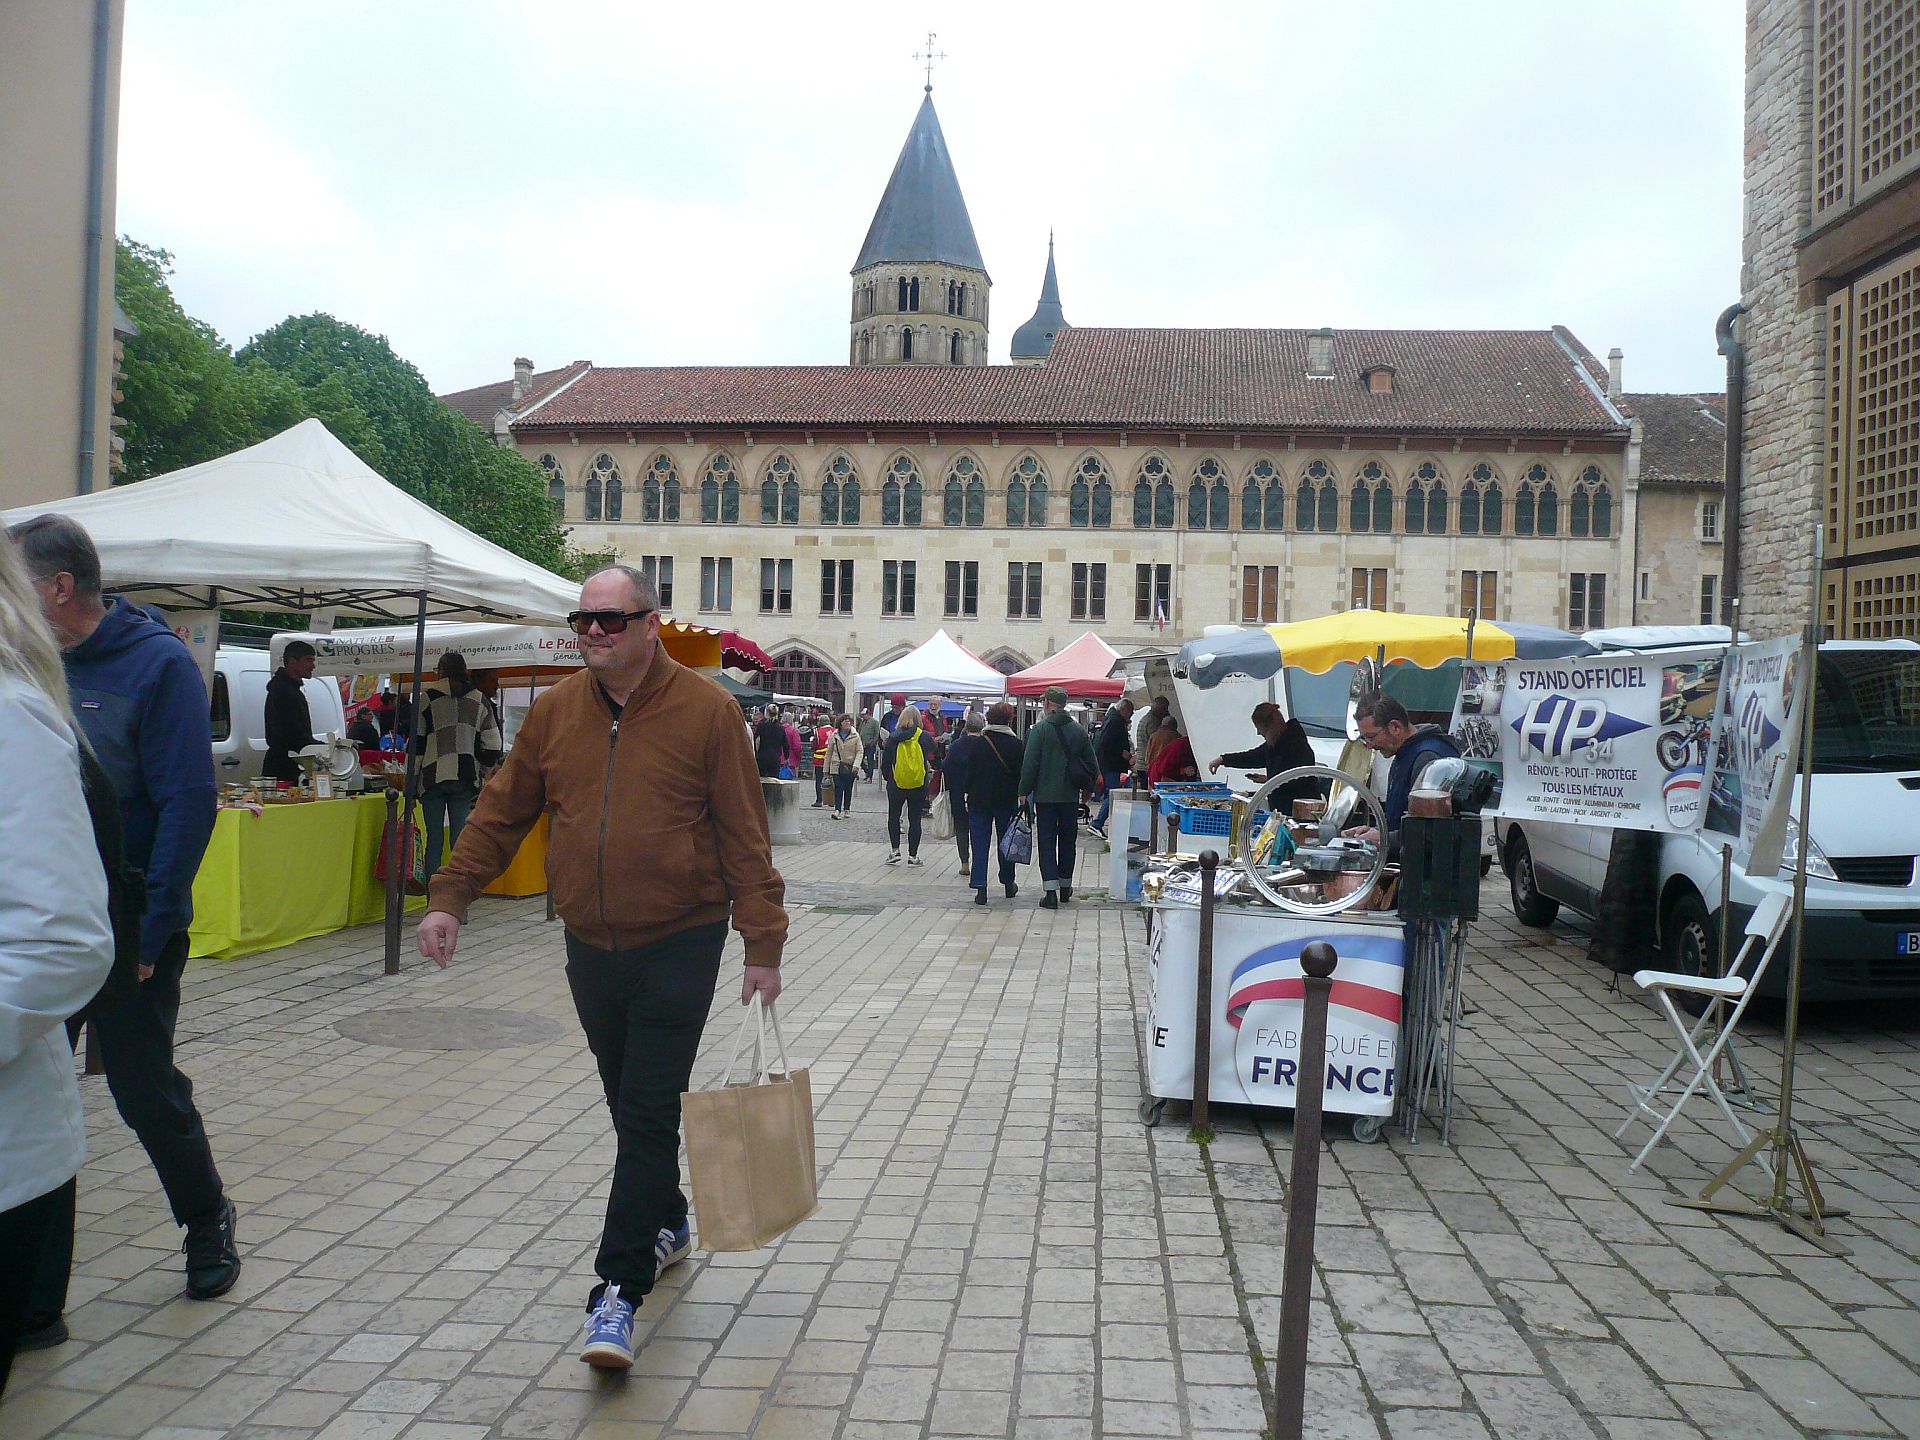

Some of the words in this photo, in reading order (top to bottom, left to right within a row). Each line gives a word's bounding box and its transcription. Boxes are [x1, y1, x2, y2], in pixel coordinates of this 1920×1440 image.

[398, 649, 418, 658] depui
[486, 643, 512, 654] depuis
[538, 638, 554, 649] Le
[1518, 670, 1569, 690] STAND
[1571, 666, 1646, 689] OFFICIEL
[1520, 699, 1607, 762] HP
[1586, 737, 1615, 763] 34
[1527, 763, 1560, 777] RÉNOVE
[1565, 766, 1589, 779] POLIT
[1595, 767, 1638, 781] PROTÈGE
[1541, 781, 1566, 794] TOUS
[1567, 783, 1582, 795] LES
[1583, 783, 1624, 798] MÉTAUX
[1526, 795, 1541, 803] ACIER
[1543, 796, 1560, 804] FONTE
[1562, 797, 1582, 806] CUIVRE
[1584, 799, 1615, 808] ALUMINIUM
[1617, 801, 1641, 810] CHROME
[1669, 801, 1699, 815] FRANCE
[1255, 1027, 1370, 1058] FABQUÉ
[1252, 1055, 1395, 1097] FRNCE
